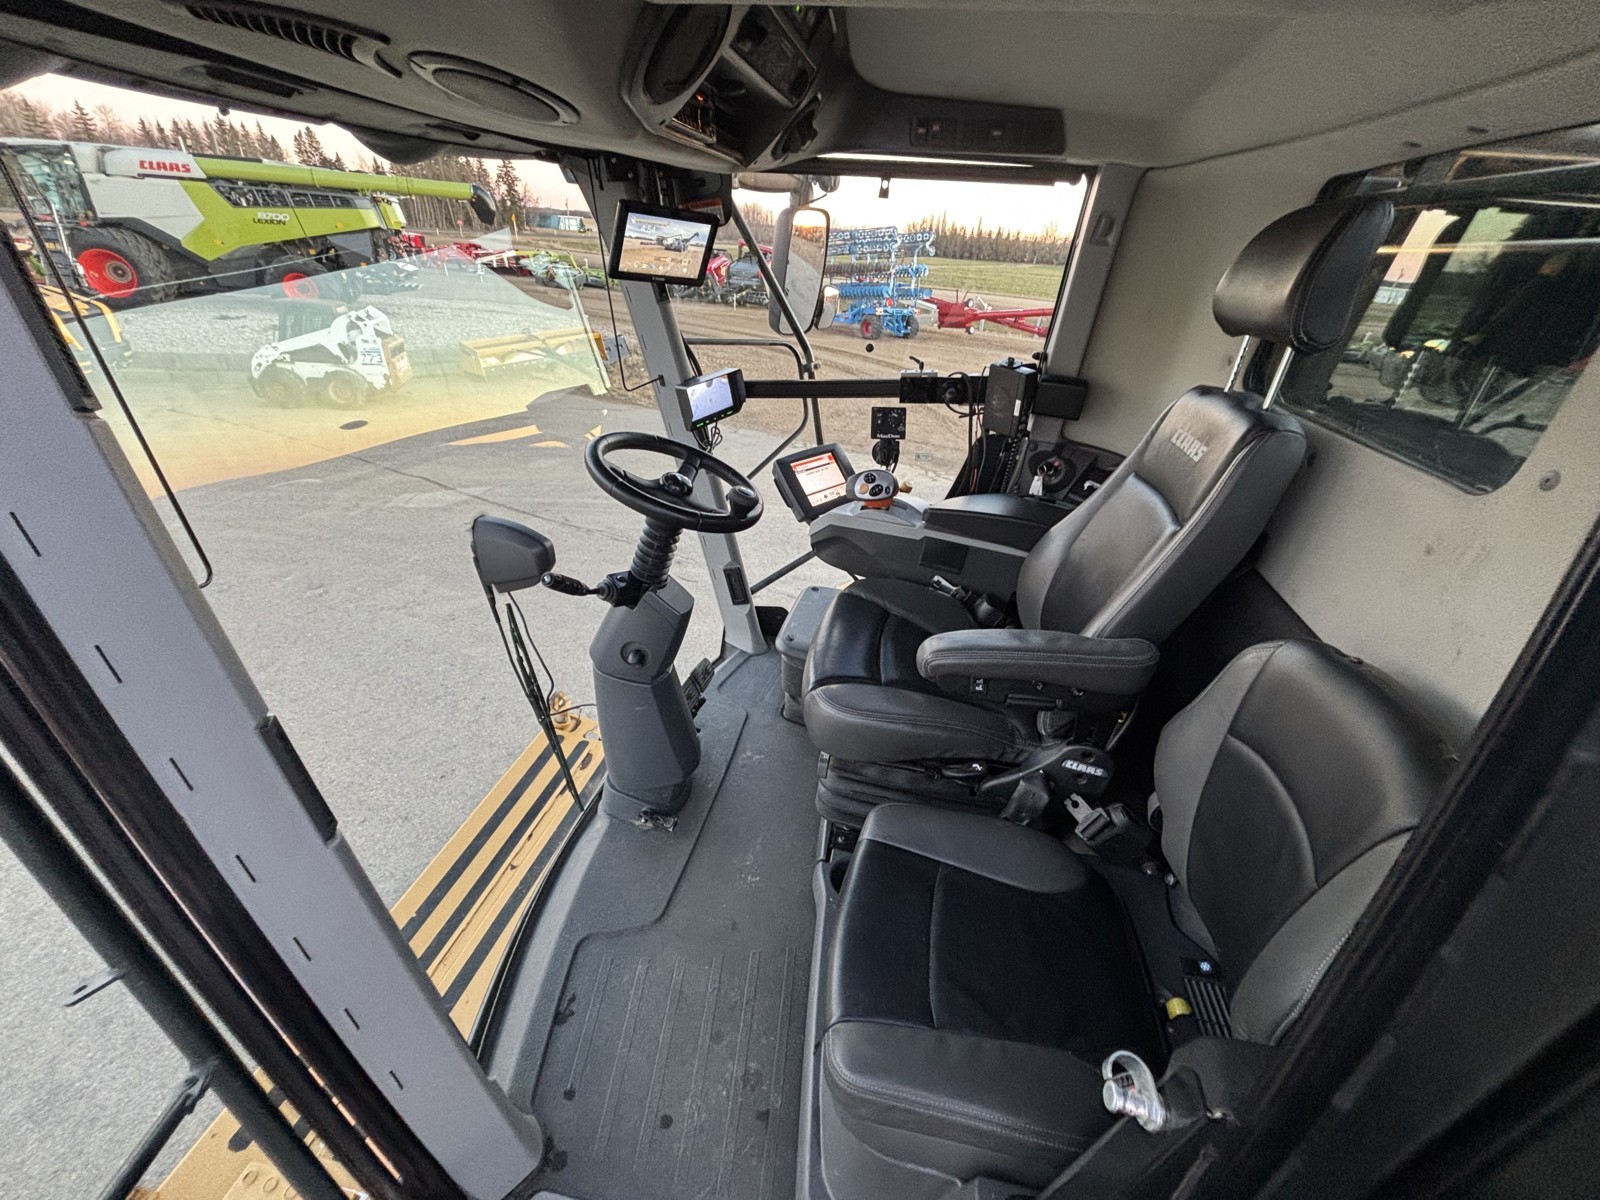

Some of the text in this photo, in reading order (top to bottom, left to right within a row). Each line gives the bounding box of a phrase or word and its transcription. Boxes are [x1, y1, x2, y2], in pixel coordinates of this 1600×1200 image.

[139, 159, 191, 173] CLAAS
[252, 217, 286, 226] LEXION
[257, 211, 289, 221] 8700
[1170, 429, 1208, 463] CLAAS
[1064, 760, 1104, 777] CLAAS
